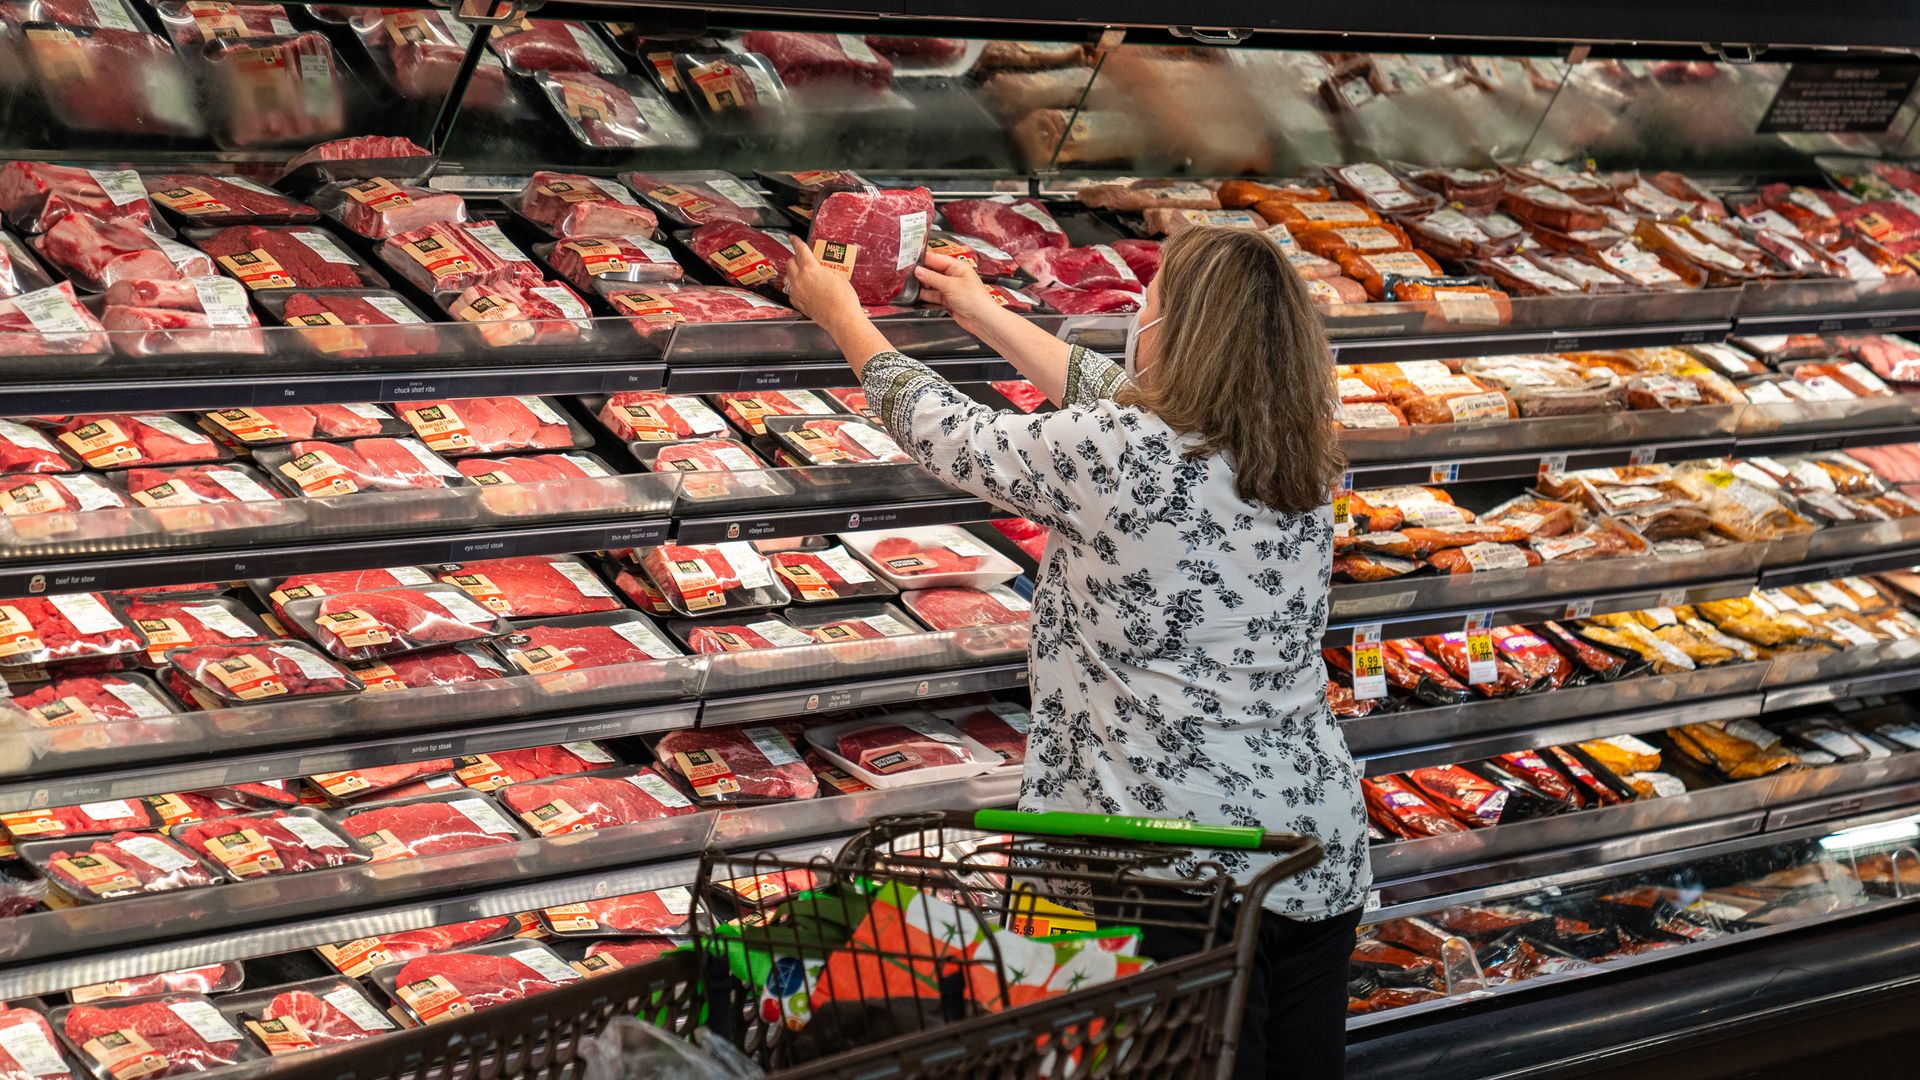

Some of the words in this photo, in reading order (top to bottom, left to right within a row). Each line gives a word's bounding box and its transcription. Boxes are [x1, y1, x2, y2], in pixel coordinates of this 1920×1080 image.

[726, 252, 758, 268] MARINATING
[740, 259, 752, 267] BEEF
[235, 262, 274, 272] MARINATING
[411, 386, 425, 394] short
[419, 419, 458, 430] MARINATING
[82, 434, 114, 446] STEWING
[93, 440, 110, 448] BEEF
[313, 471, 328, 480] BEEF
[748, 527, 763, 535] ribeye
[464, 544, 474, 552] eye
[234, 563, 246, 572] flex
[55, 577, 70, 585] beef
[71, 576, 80, 584] for
[680, 580, 704, 590] BROILING
[704, 578, 717, 586] BEEF
[147, 631, 178, 639] STEWING
[1471, 641, 1489, 654] 6.99
[529, 657, 565, 671] MARINATING
[1358, 655, 1379, 668] 6.99
[543, 664, 557, 672] BEEF
[229, 669, 260, 679] STEWING
[240, 674, 256, 682] BEEF
[601, 722, 622, 730] braciole
[412, 745, 429, 753] sirloin
[460, 762, 495, 773] MARINATING
[690, 765, 716, 773] GRILLING
[688, 771, 715, 780] BROILING
[715, 767, 728, 775] BEEF
[334, 946, 362, 963] BROILING
[362, 939, 377, 950] BEEF
[336, 941, 363, 957] GRILLING
[416, 992, 442, 1005] GRILLING
[416, 997, 443, 1011] BROILING
[443, 991, 458, 1001] BEEF
